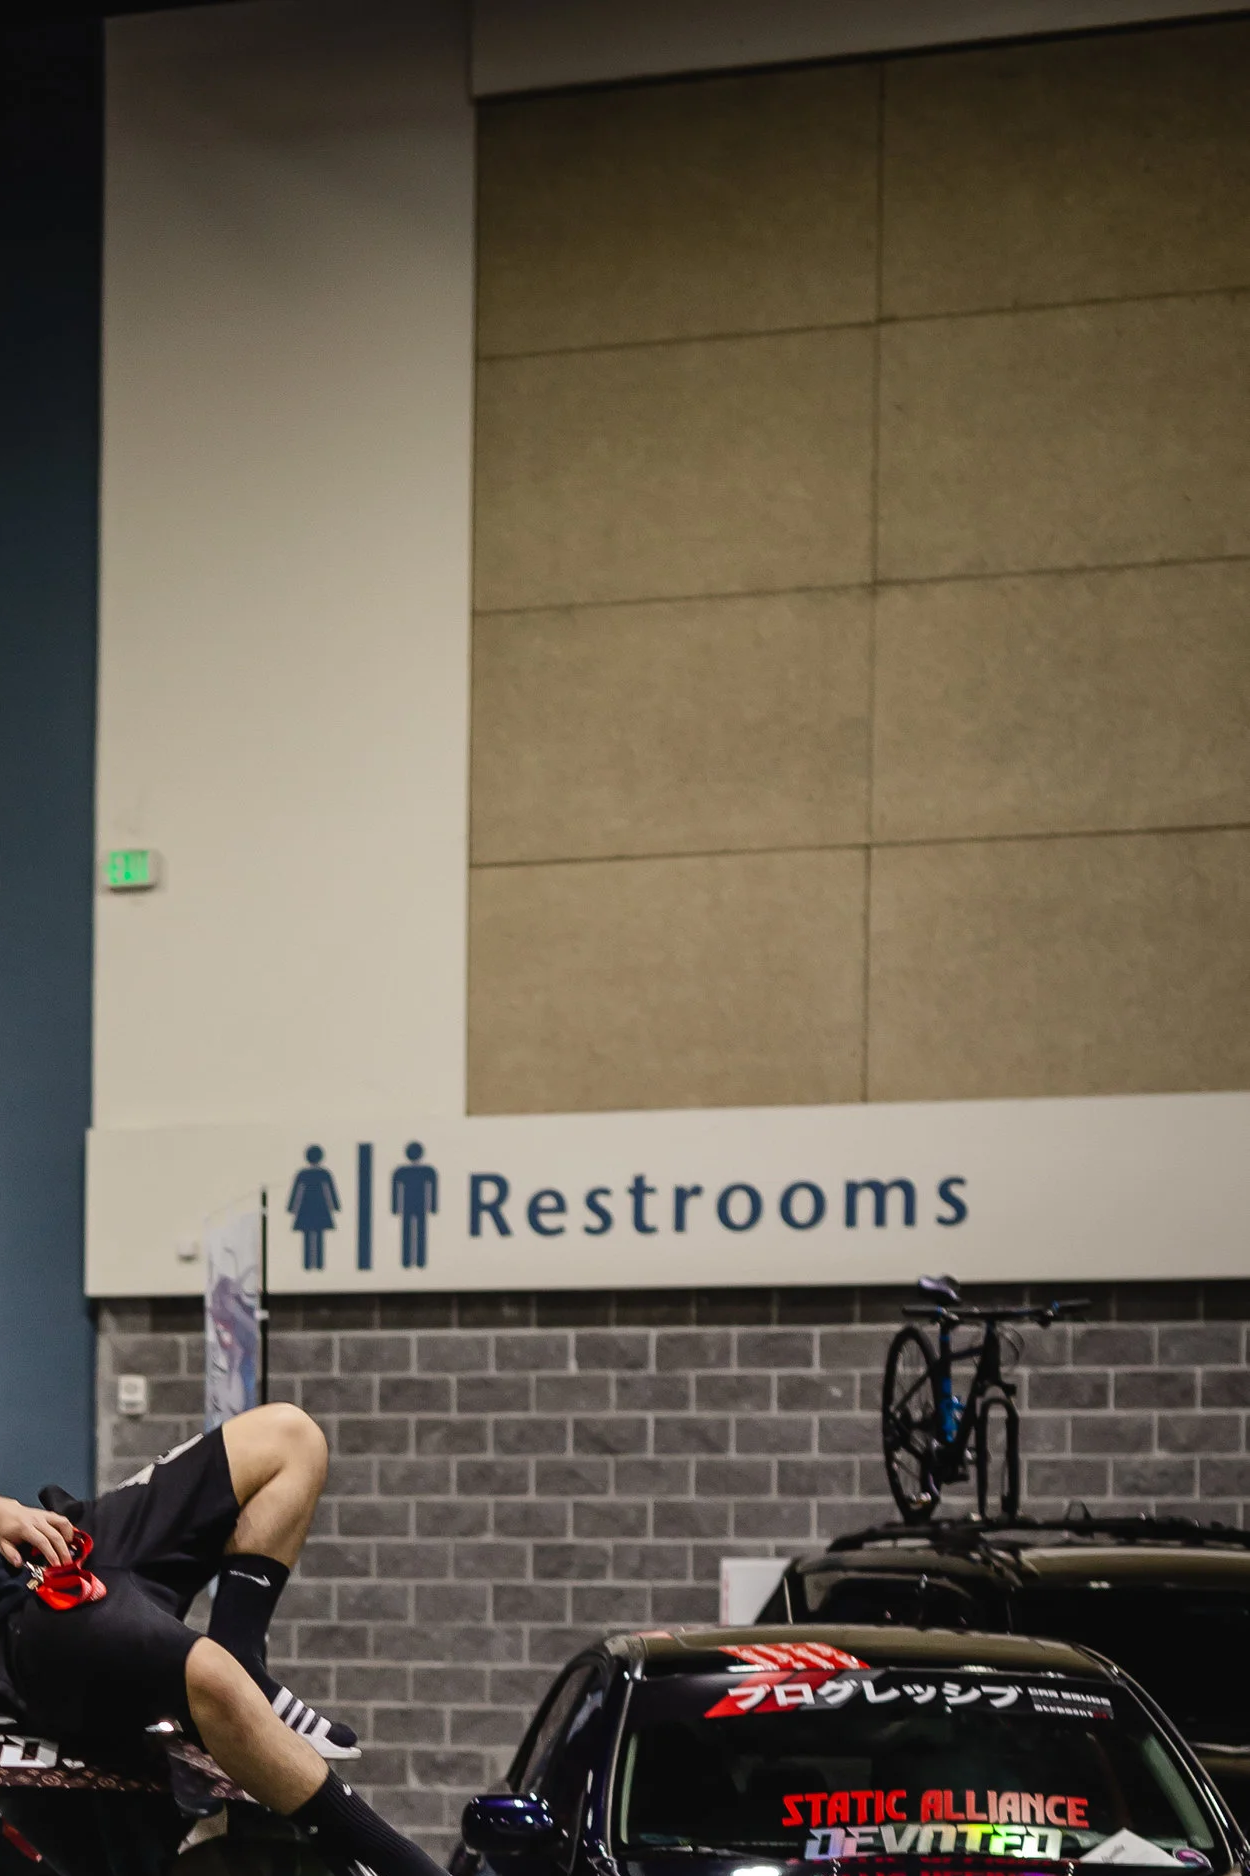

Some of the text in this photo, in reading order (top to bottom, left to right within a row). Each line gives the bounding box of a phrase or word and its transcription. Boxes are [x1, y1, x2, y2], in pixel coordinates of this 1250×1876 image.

[466, 1172, 970, 1239] Restrooms
[727, 1680, 1023, 1711] プログレッシブ
[782, 1790, 1090, 1828] STATIC ALLIANCE
[804, 1824, 1062, 1861] DEVOTED
